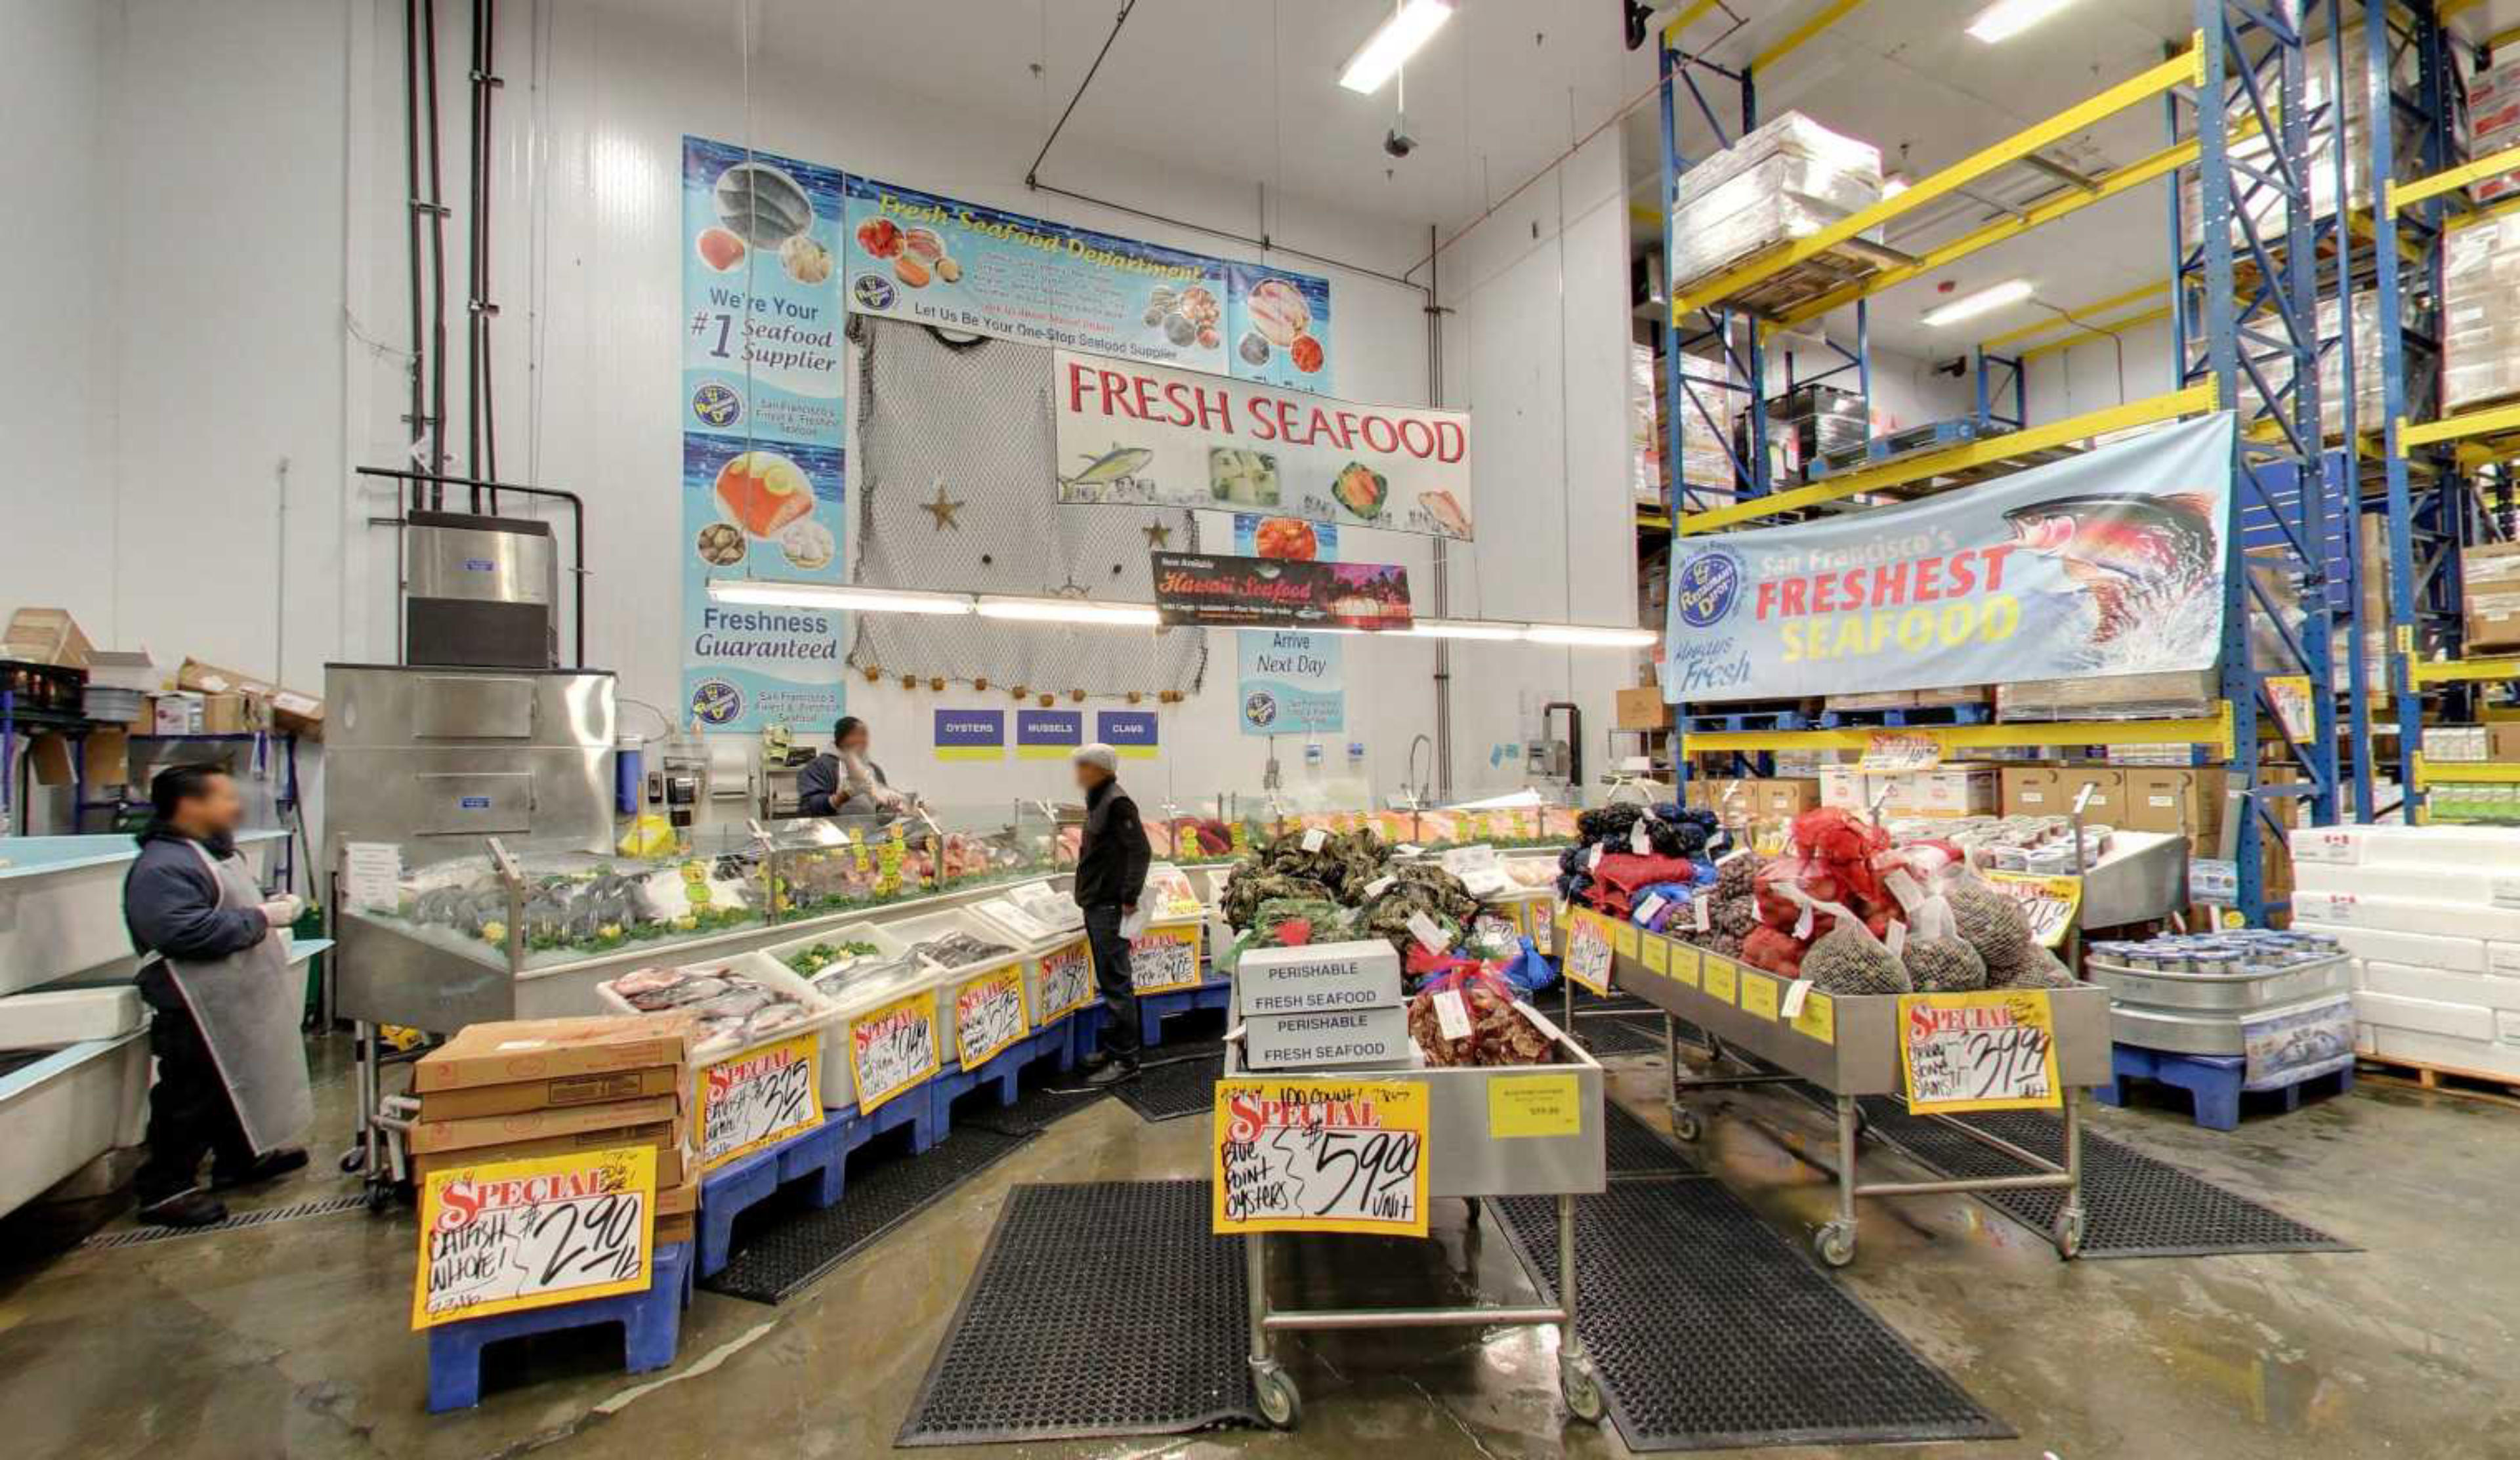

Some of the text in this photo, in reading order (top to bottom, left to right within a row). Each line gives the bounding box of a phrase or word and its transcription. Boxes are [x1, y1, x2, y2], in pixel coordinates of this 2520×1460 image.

[879, 195, 949, 224] Fresh
[959, 212, 1061, 253] Seafood
[1067, 238, 1204, 281] Department
[709, 287, 819, 322] We're Your
[915, 302, 935, 318] Let
[940, 307, 957, 322] Us
[961, 311, 979, 326] Be
[984, 318, 1014, 334] Your
[741, 318, 833, 348] Seafood
[741, 341, 837, 373] Supplier
[1069, 362, 1464, 463] FRESH SEAFOOD
[1762, 526, 1957, 575] San Francisco's
[1239, 575, 1312, 604] Seafood
[1755, 543, 2019, 622] FRESHEST
[704, 608, 828, 634] Freshness
[1779, 593, 2021, 664] SEAFOOD
[695, 633, 837, 659] Guaranteed
[1273, 633, 1311, 650] Arrive
[1257, 655, 1327, 677] Next Day
[1680, 650, 1751, 692] Fresh
[946, 723, 994, 733] OYSTERS
[1028, 724, 1073, 733] MUSSELS
[1112, 724, 1144, 733] CLAMS
[1268, 962, 1358, 980] PERISHABLE
[1255, 990, 1377, 1011] FRESH SEAFOOD
[1278, 1014, 1368, 1032] PERISHABLE
[1264, 1042, 1385, 1062] FRESH SEAFOOD
[1227, 1095, 1381, 1142] SPECIAL
[436, 1171, 610, 1230] SPECIAL
